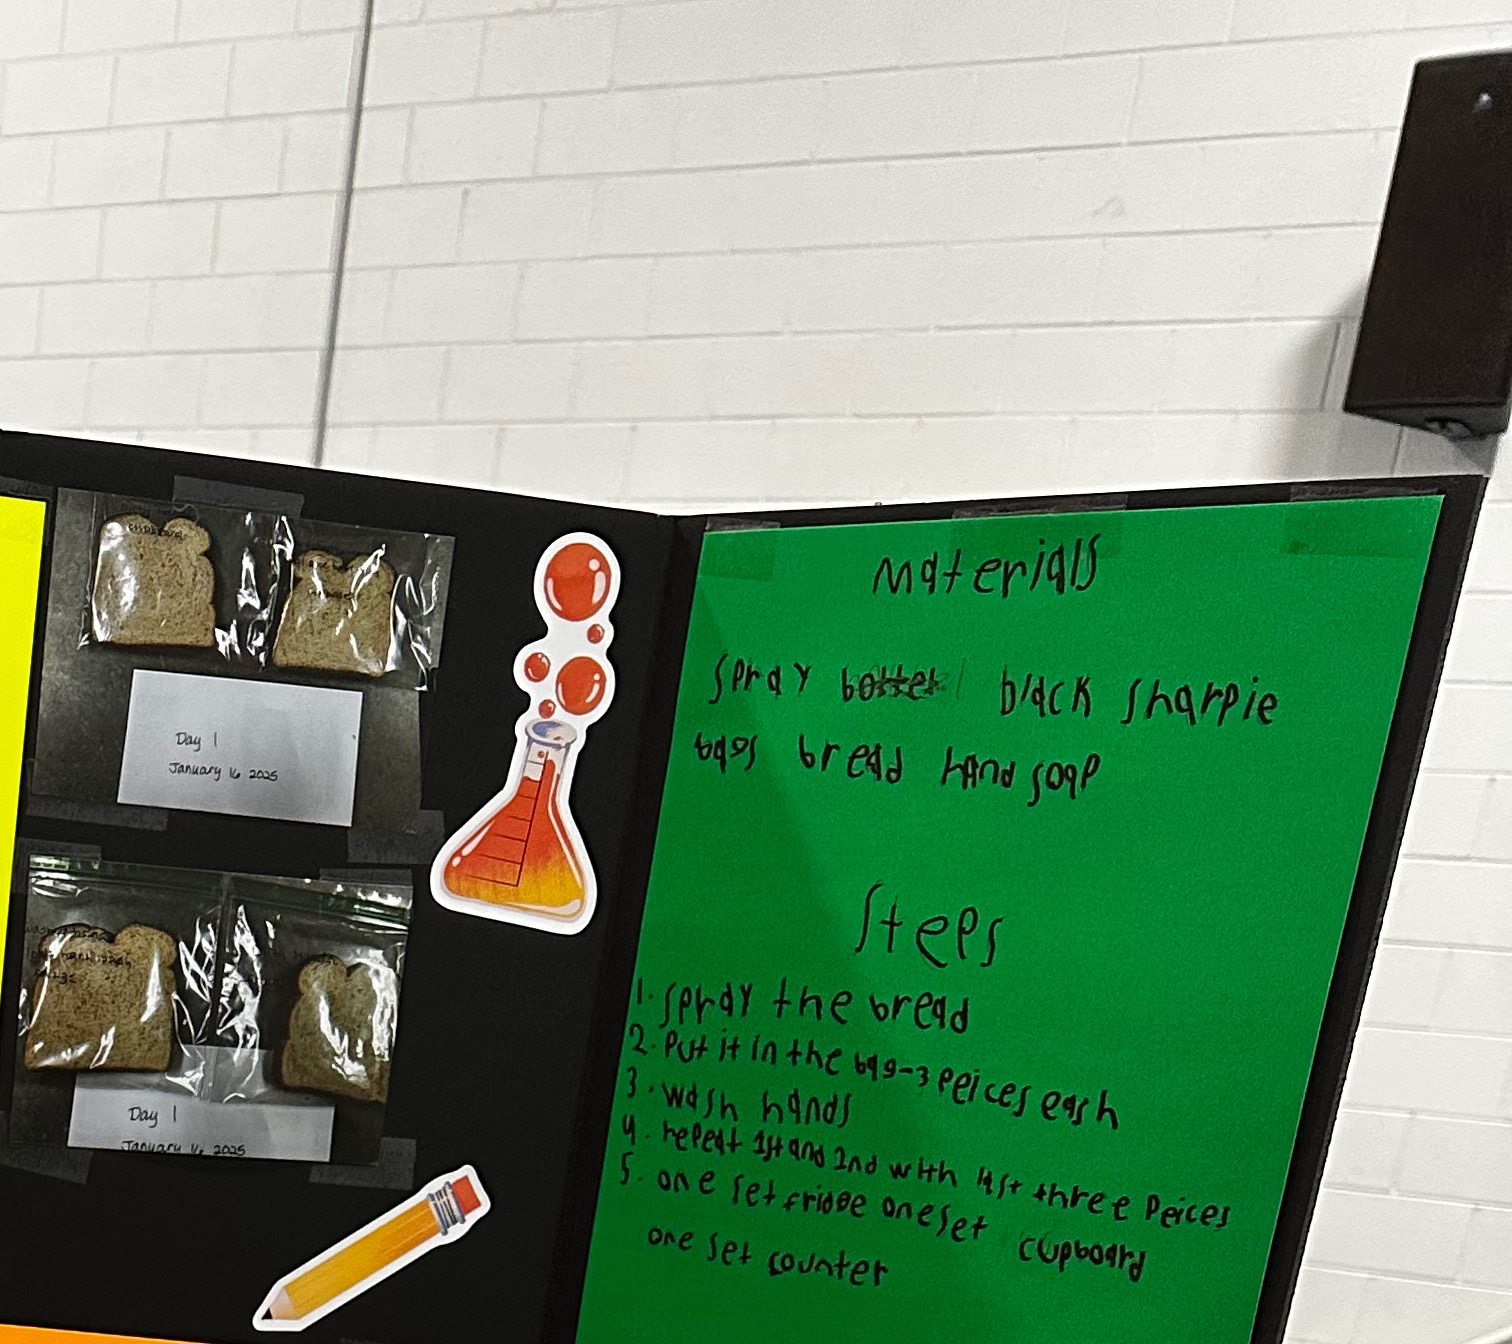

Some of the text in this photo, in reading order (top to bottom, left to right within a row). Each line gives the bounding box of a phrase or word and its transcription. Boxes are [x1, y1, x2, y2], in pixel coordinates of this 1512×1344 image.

[1000, 669, 1091, 718] black
[175, 731, 202, 753] Day
[798, 734, 903, 785] bread
[168, 762, 278, 782] January 2025
[772, 977, 853, 1025] the
[868, 991, 969, 1034] bread
[718, 1028, 843, 1076] it in the
[128, 1106, 159, 1129] Day
[761, 1087, 852, 1129] hands
[657, 1169, 716, 1195] one
[731, 1173, 776, 1208] set
[882, 1195, 934, 1227] one
[935, 1204, 988, 1243] set
[1032, 1182, 1131, 1221] three
[647, 1227, 889, 1287] one set counter
